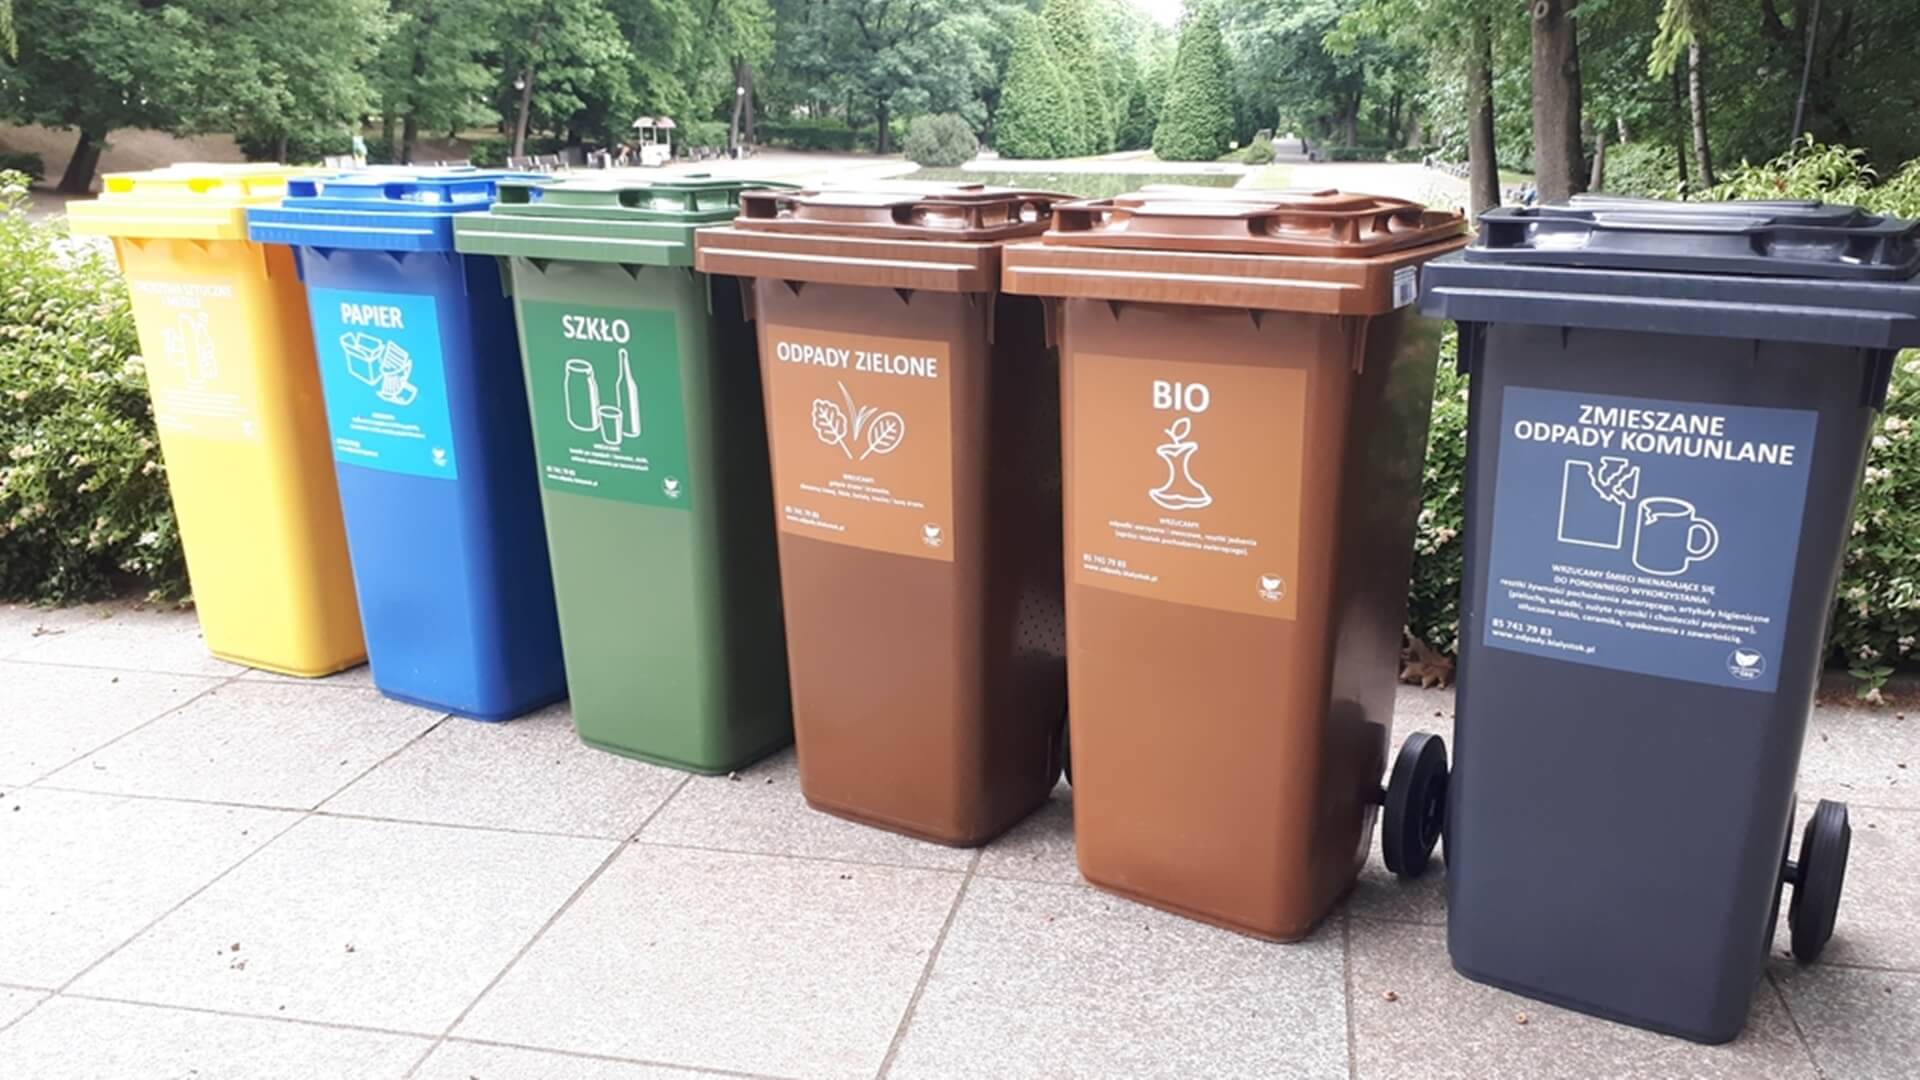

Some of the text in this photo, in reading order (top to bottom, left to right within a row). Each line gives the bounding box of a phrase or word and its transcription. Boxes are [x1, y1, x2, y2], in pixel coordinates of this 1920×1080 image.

[340, 303, 403, 329] PAPIER
[562, 315, 630, 343] SZKŁO
[777, 341, 938, 378] ODPADY ZIELONE
[1153, 380, 1210, 413] BIO
[1578, 404, 1725, 437] ZMIESZANE
[1514, 420, 1795, 466] ODPADY KOMUNLANE
[1552, 565, 1714, 595] WRZUCAMY ŚMIECI NIENADAJĄCE SIĘ
[1554, 576, 1567, 584] DO
[1570, 578, 1629, 593] PONOWNEGO
[1493, 619, 1552, 636] 85 741 79 83
